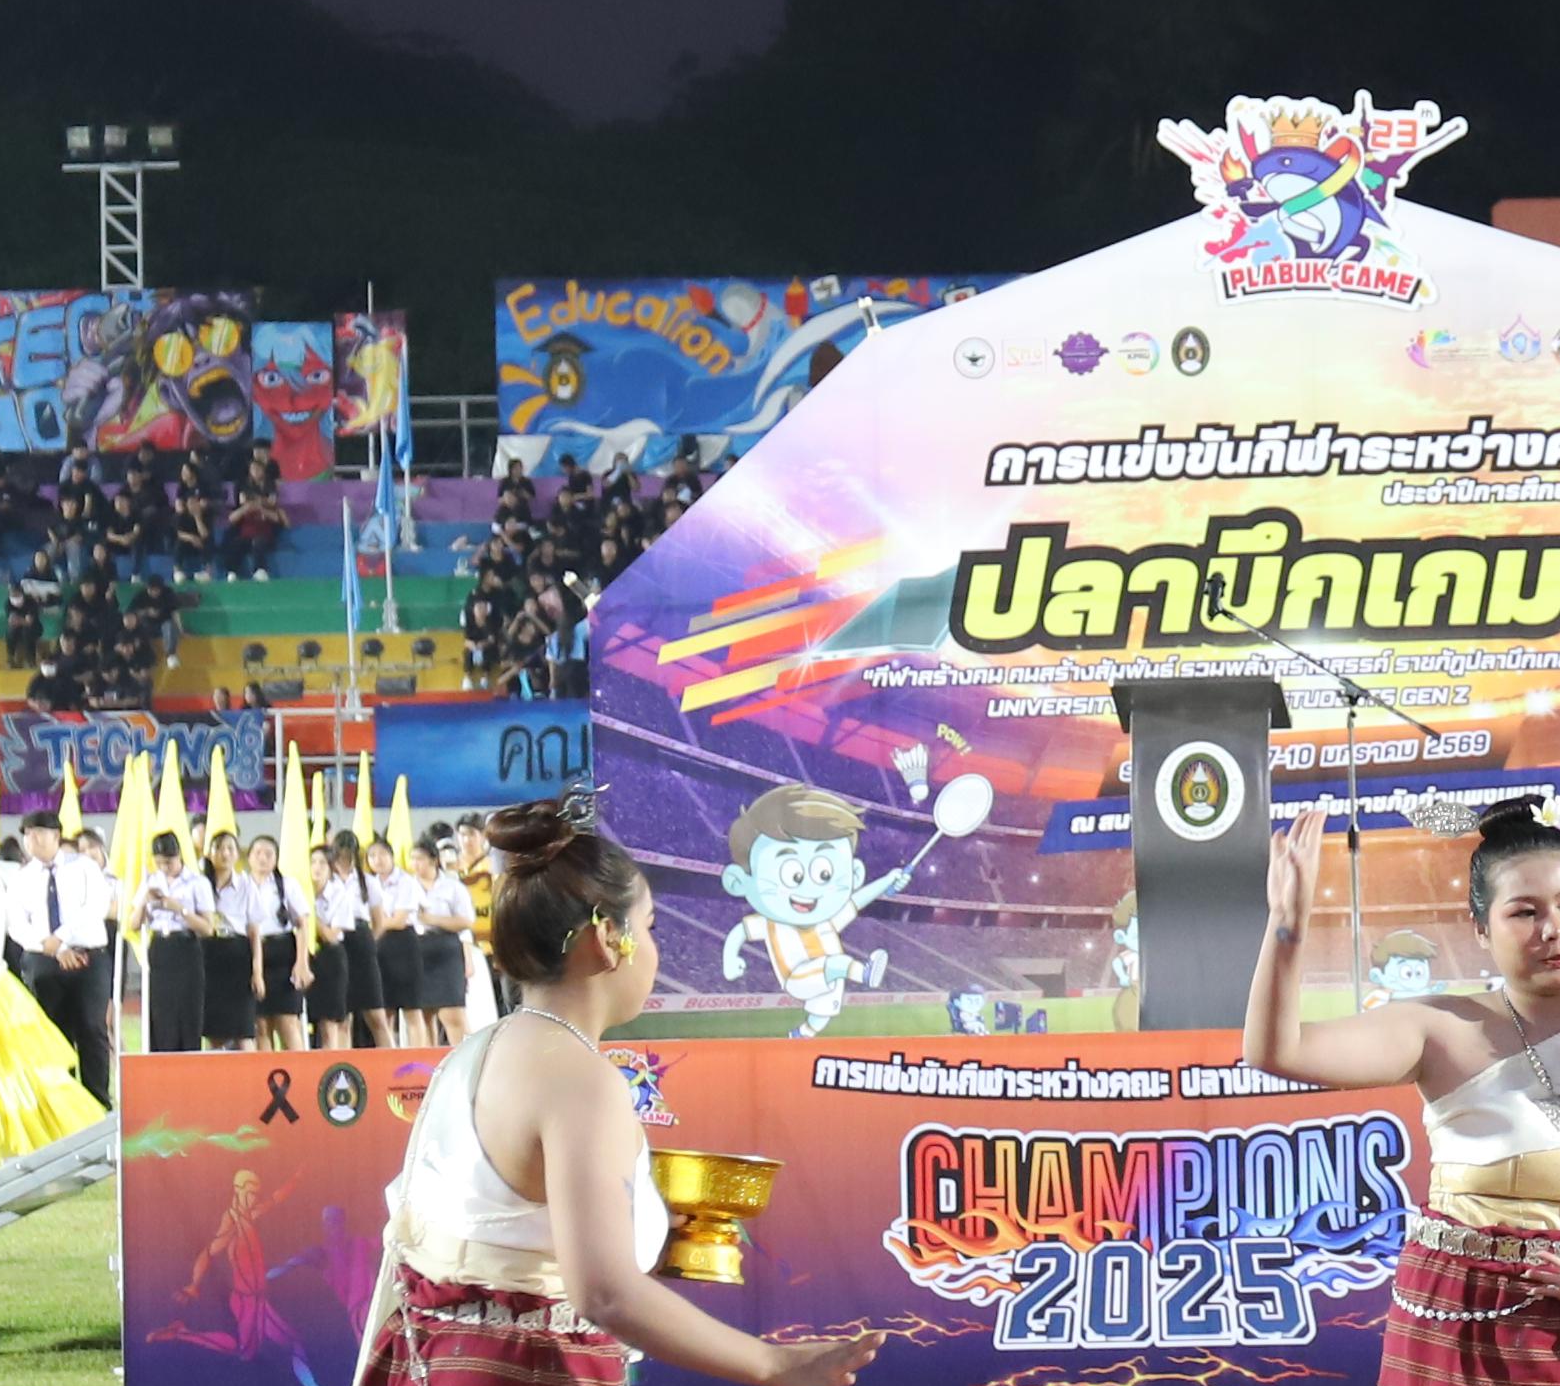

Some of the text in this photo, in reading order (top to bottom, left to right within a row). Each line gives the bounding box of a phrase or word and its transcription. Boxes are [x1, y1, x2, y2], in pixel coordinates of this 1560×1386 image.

[1370, 119, 1417, 149] 23
[1229, 262, 1419, 297] PLABUK GAME
[1401, 687, 1451, 706] GEN
[1453, 684, 1471, 705] Z
[1320, 737, 1418, 766] มกราคม
[1424, 730, 1491, 760] 2569
[814, 1054, 1170, 1100] การแข่งขันกีฬาระหว่างคณะ
[911, 1120, 1404, 1253] CHAMPIONS
[1003, 1239, 1312, 1346] 2025
